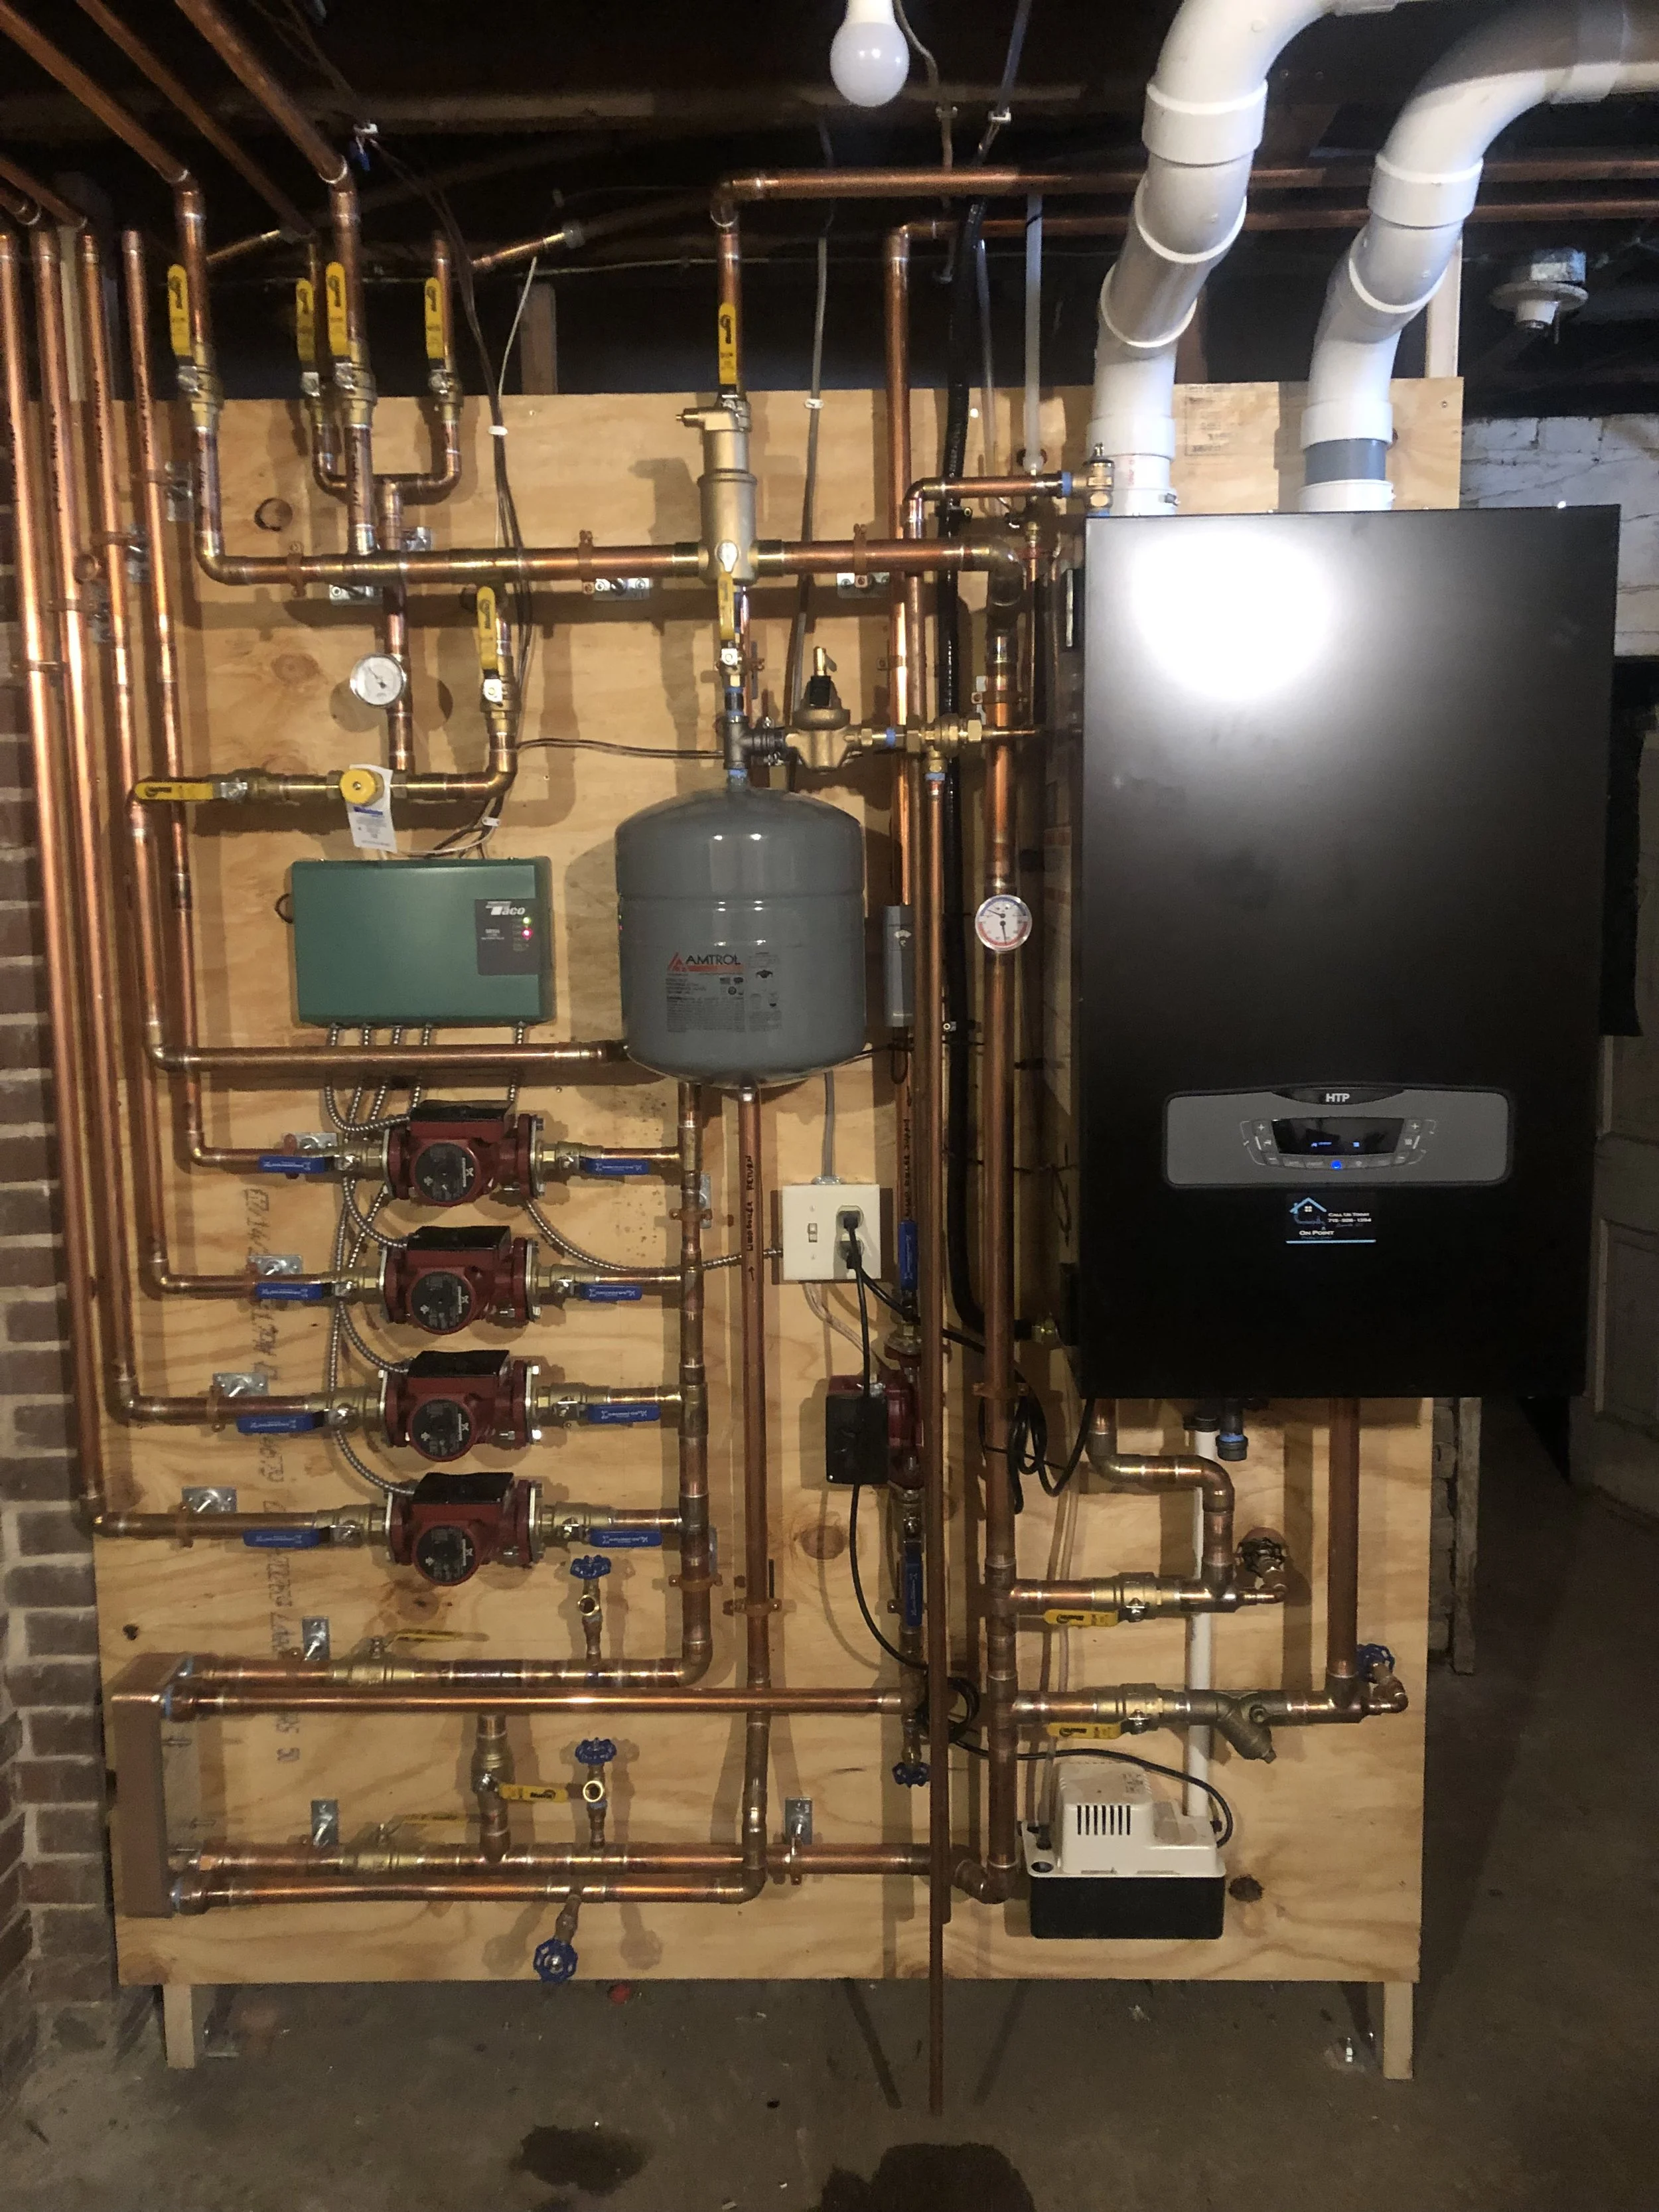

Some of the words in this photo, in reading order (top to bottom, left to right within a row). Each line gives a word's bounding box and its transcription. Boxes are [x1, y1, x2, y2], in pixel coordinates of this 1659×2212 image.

[486, 901, 526, 915] Taco
[685, 954, 741, 966] AMTROL
[1326, 1093, 1350, 1102] HTP
